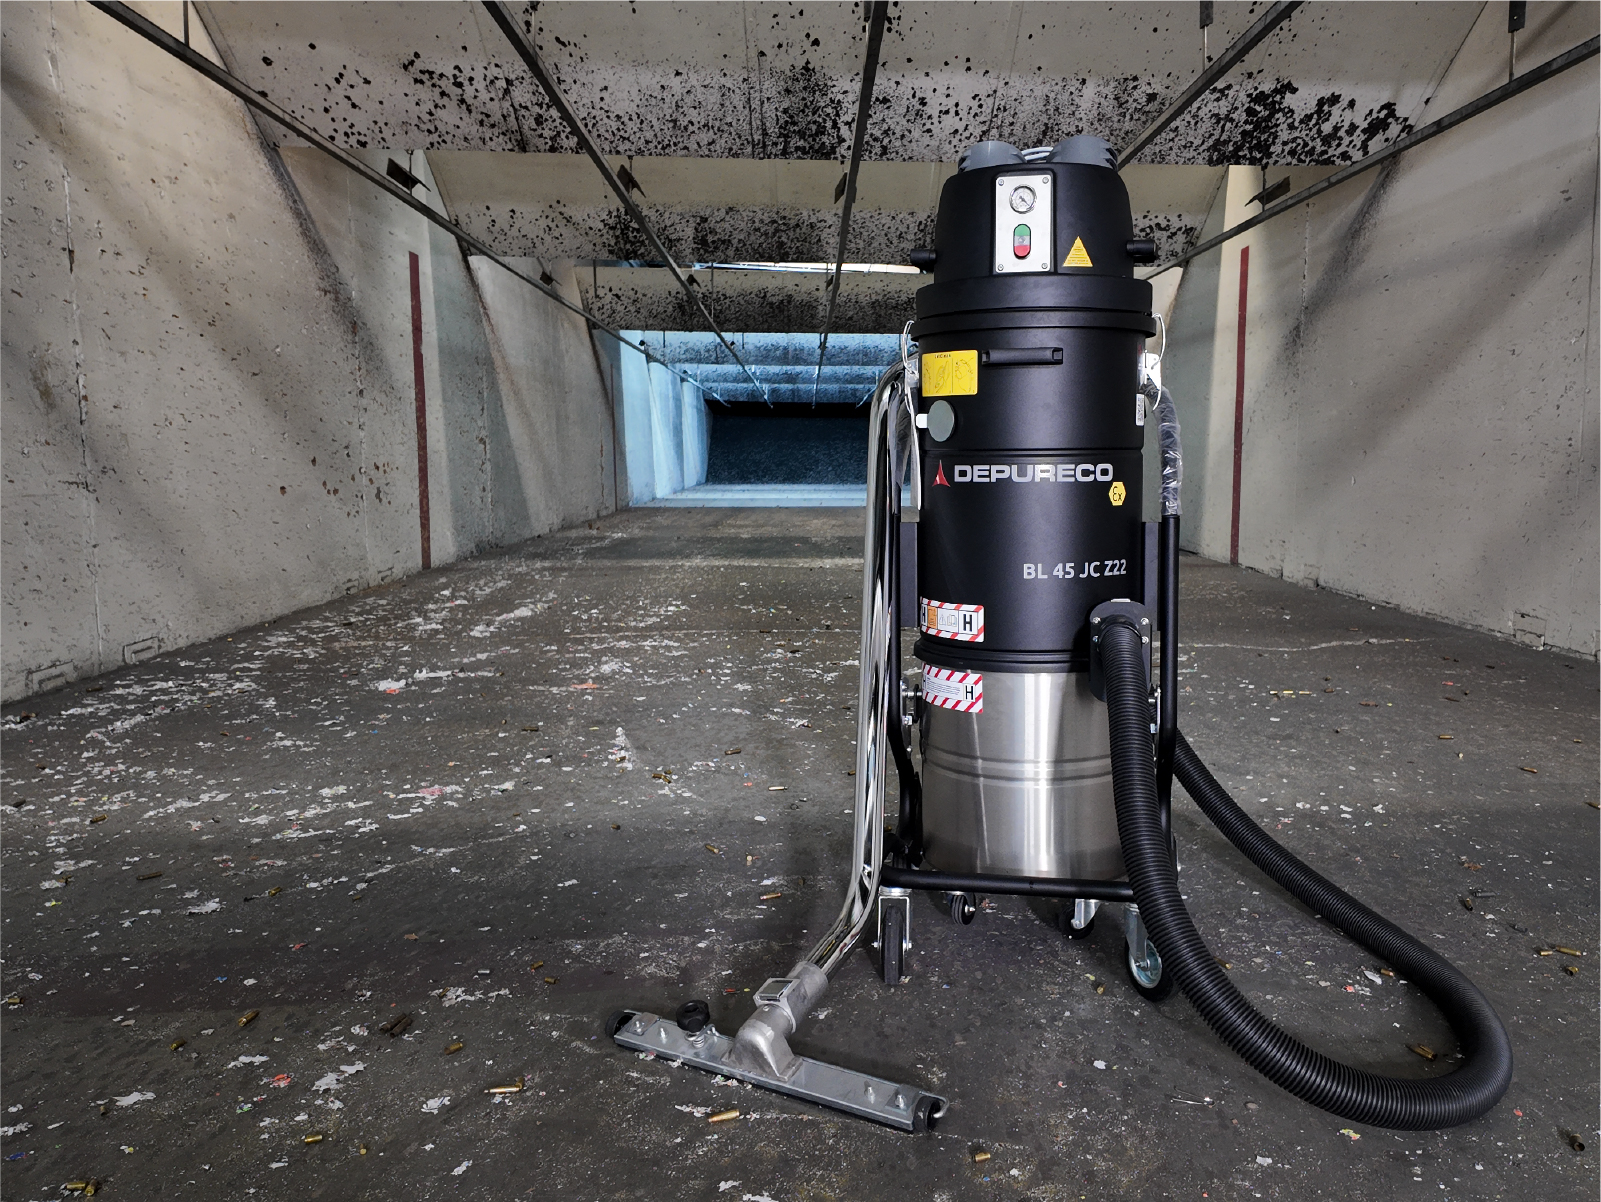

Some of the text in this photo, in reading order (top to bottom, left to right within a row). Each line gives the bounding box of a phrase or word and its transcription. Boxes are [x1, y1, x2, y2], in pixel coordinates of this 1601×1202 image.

[954, 463, 1114, 483] DEPURECO
[1112, 485, 1123, 502] Ex
[1023, 559, 1127, 579] BL 45 JC Z22
[963, 613, 973, 632] H
[965, 685, 974, 700] H
